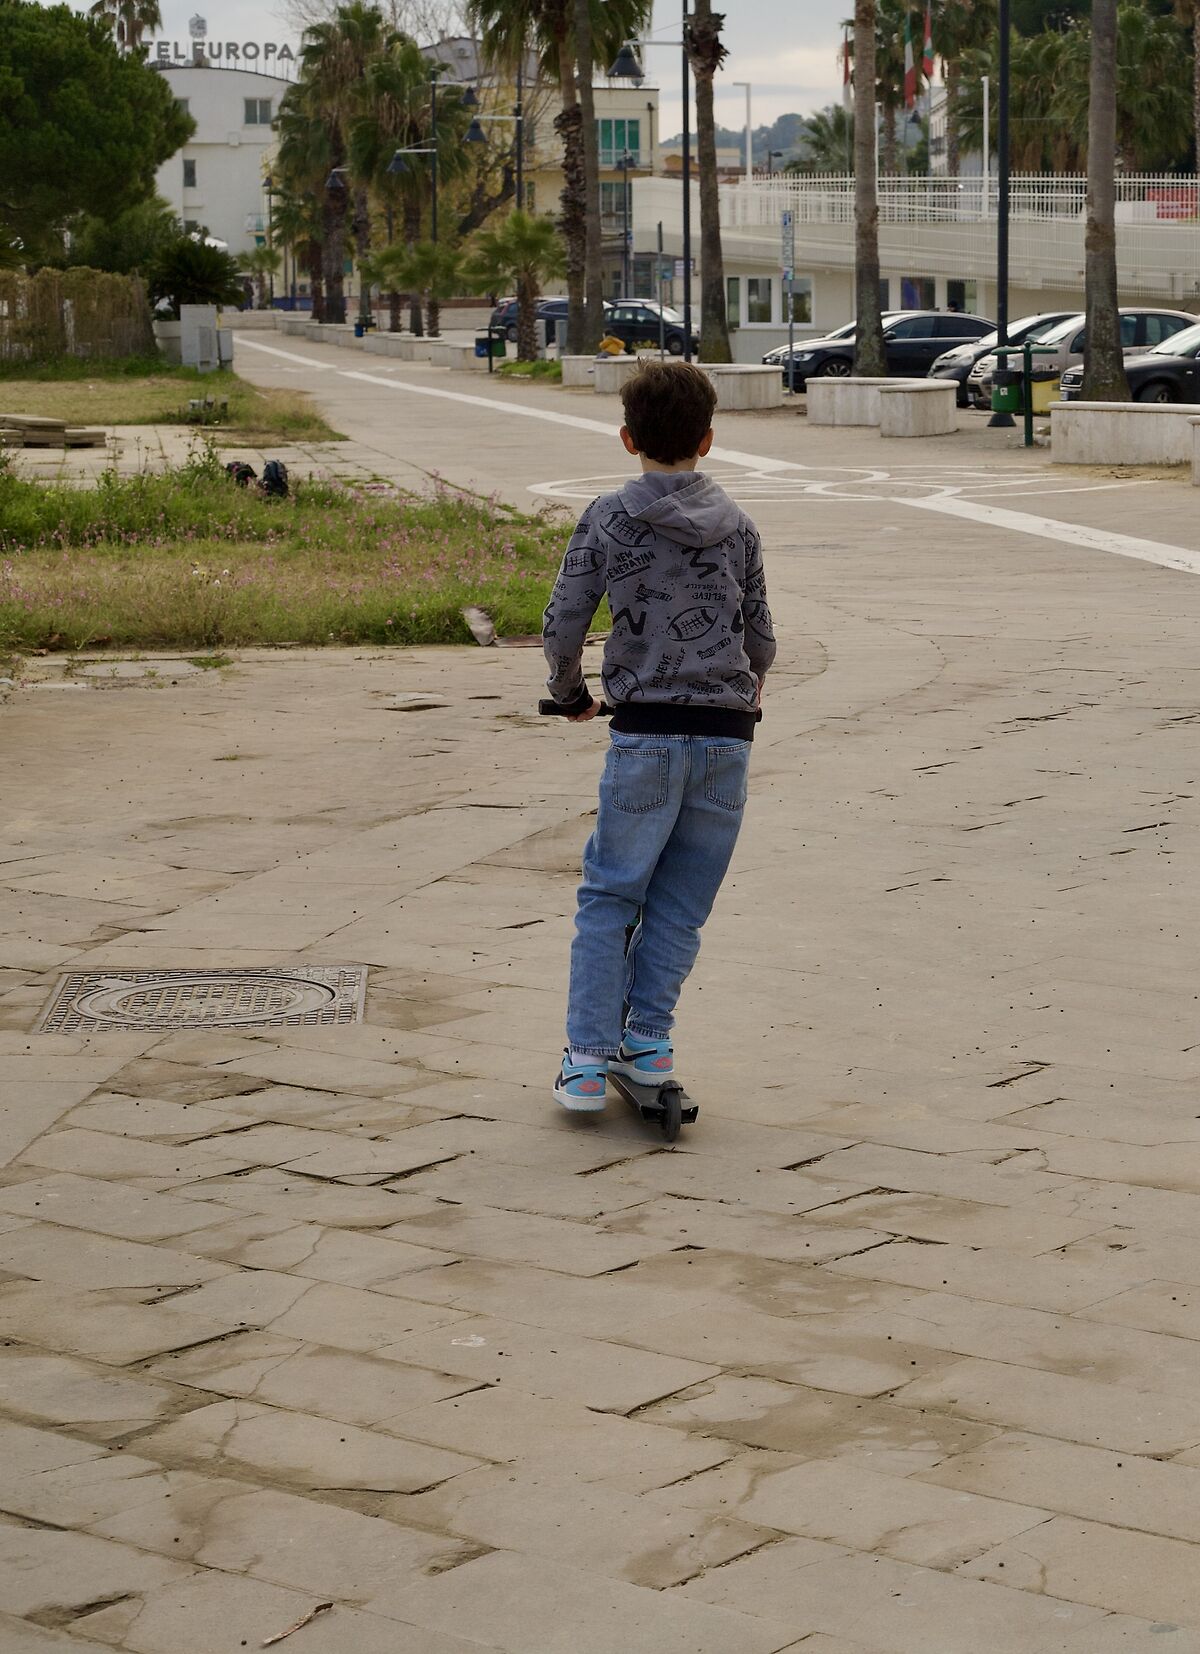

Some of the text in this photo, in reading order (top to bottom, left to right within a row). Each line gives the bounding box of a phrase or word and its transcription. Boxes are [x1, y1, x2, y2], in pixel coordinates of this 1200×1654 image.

[192, 41, 294, 61] EUROPA
[615, 550, 633, 564] NEW
[693, 592, 727, 602] BELIEVE
